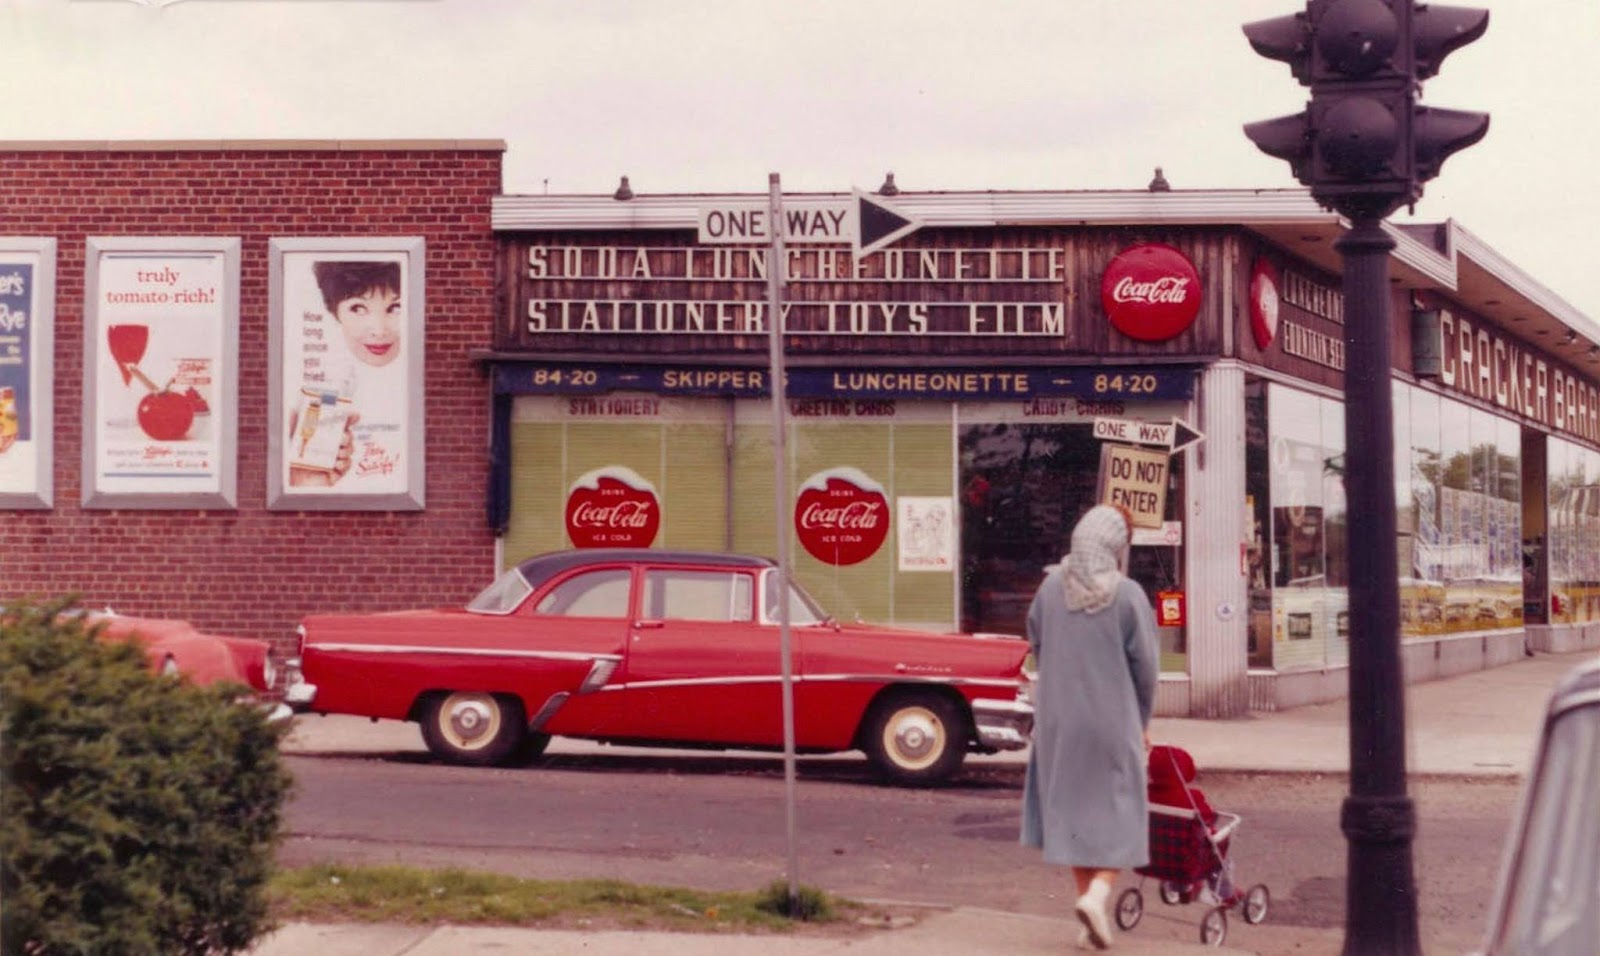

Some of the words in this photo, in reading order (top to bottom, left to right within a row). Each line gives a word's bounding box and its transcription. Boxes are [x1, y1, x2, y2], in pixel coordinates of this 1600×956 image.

[706, 210, 765, 238] ONE
[786, 210, 847, 237] WAY
[137, 267, 180, 286] truly
[528, 246, 652, 280] SODA
[686, 247, 1065, 282] LUNCHEONETTE
[528, 299, 792, 334] STATIONERY
[828, 302, 928, 335] TOYS
[968, 302, 1065, 336] FILM
[833, 373, 1029, 391] LUNCHEONETTE
[1440, 309, 1548, 423] CRACKER
[1554, 369, 1600, 443] BARR
[1097, 421, 1127, 439] ONE
[1140, 426, 1168, 442] WAY
[1111, 457, 1131, 480] DO
[1136, 460, 1164, 484] NOT
[1112, 487, 1158, 515] ENTER
